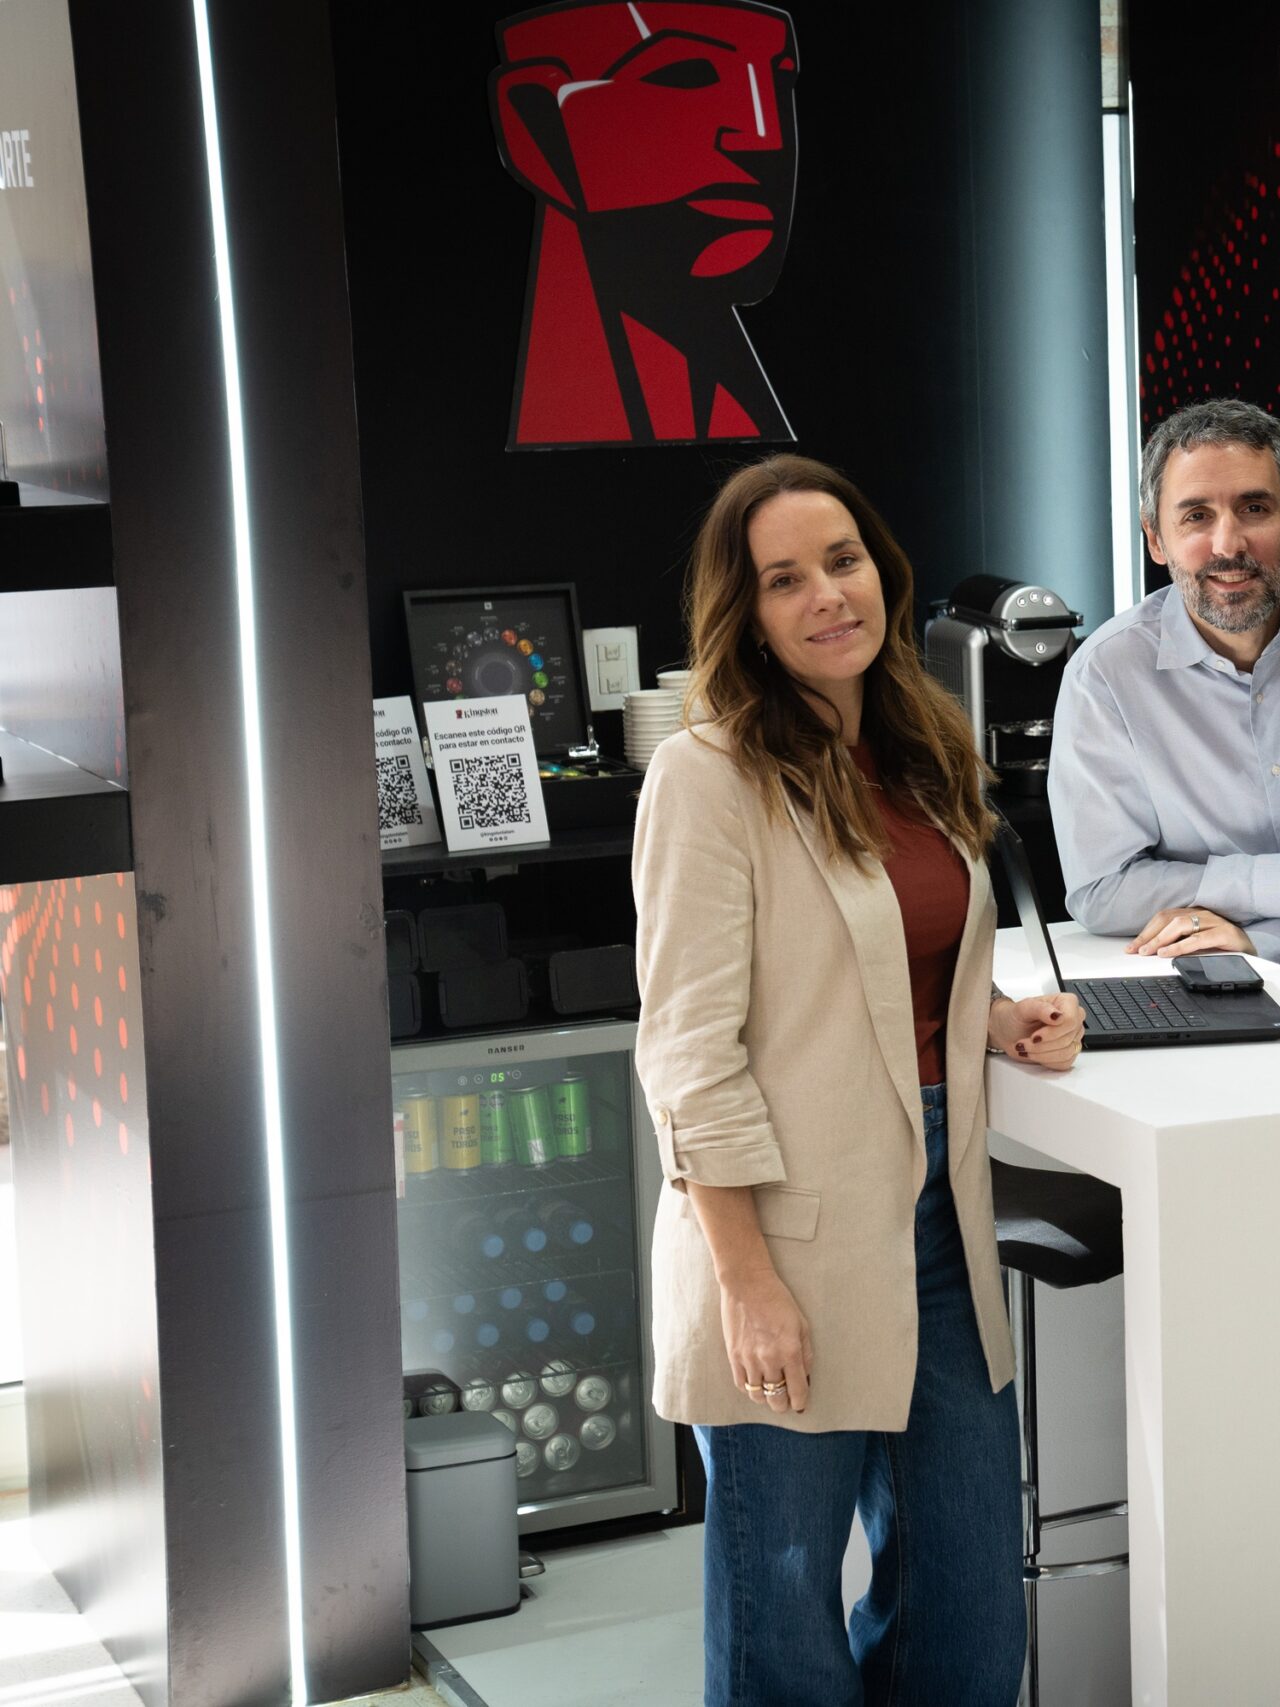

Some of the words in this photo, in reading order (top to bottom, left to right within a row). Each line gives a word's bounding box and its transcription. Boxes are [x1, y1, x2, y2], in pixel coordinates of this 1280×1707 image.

[464, 707, 498, 718] Kingston
[375, 728, 401, 738] código
[401, 726, 413, 735] QR
[434, 731, 467, 740] Escanea
[469, 730, 485, 738] este
[486, 727, 513, 738] código
[514, 725, 526, 734] QR
[380, 737, 412, 747] contacto
[439, 742, 457, 751] para
[458, 740, 478, 748] estar
[491, 736, 524, 746] contacto
[490, 1072, 505, 1083] 05
